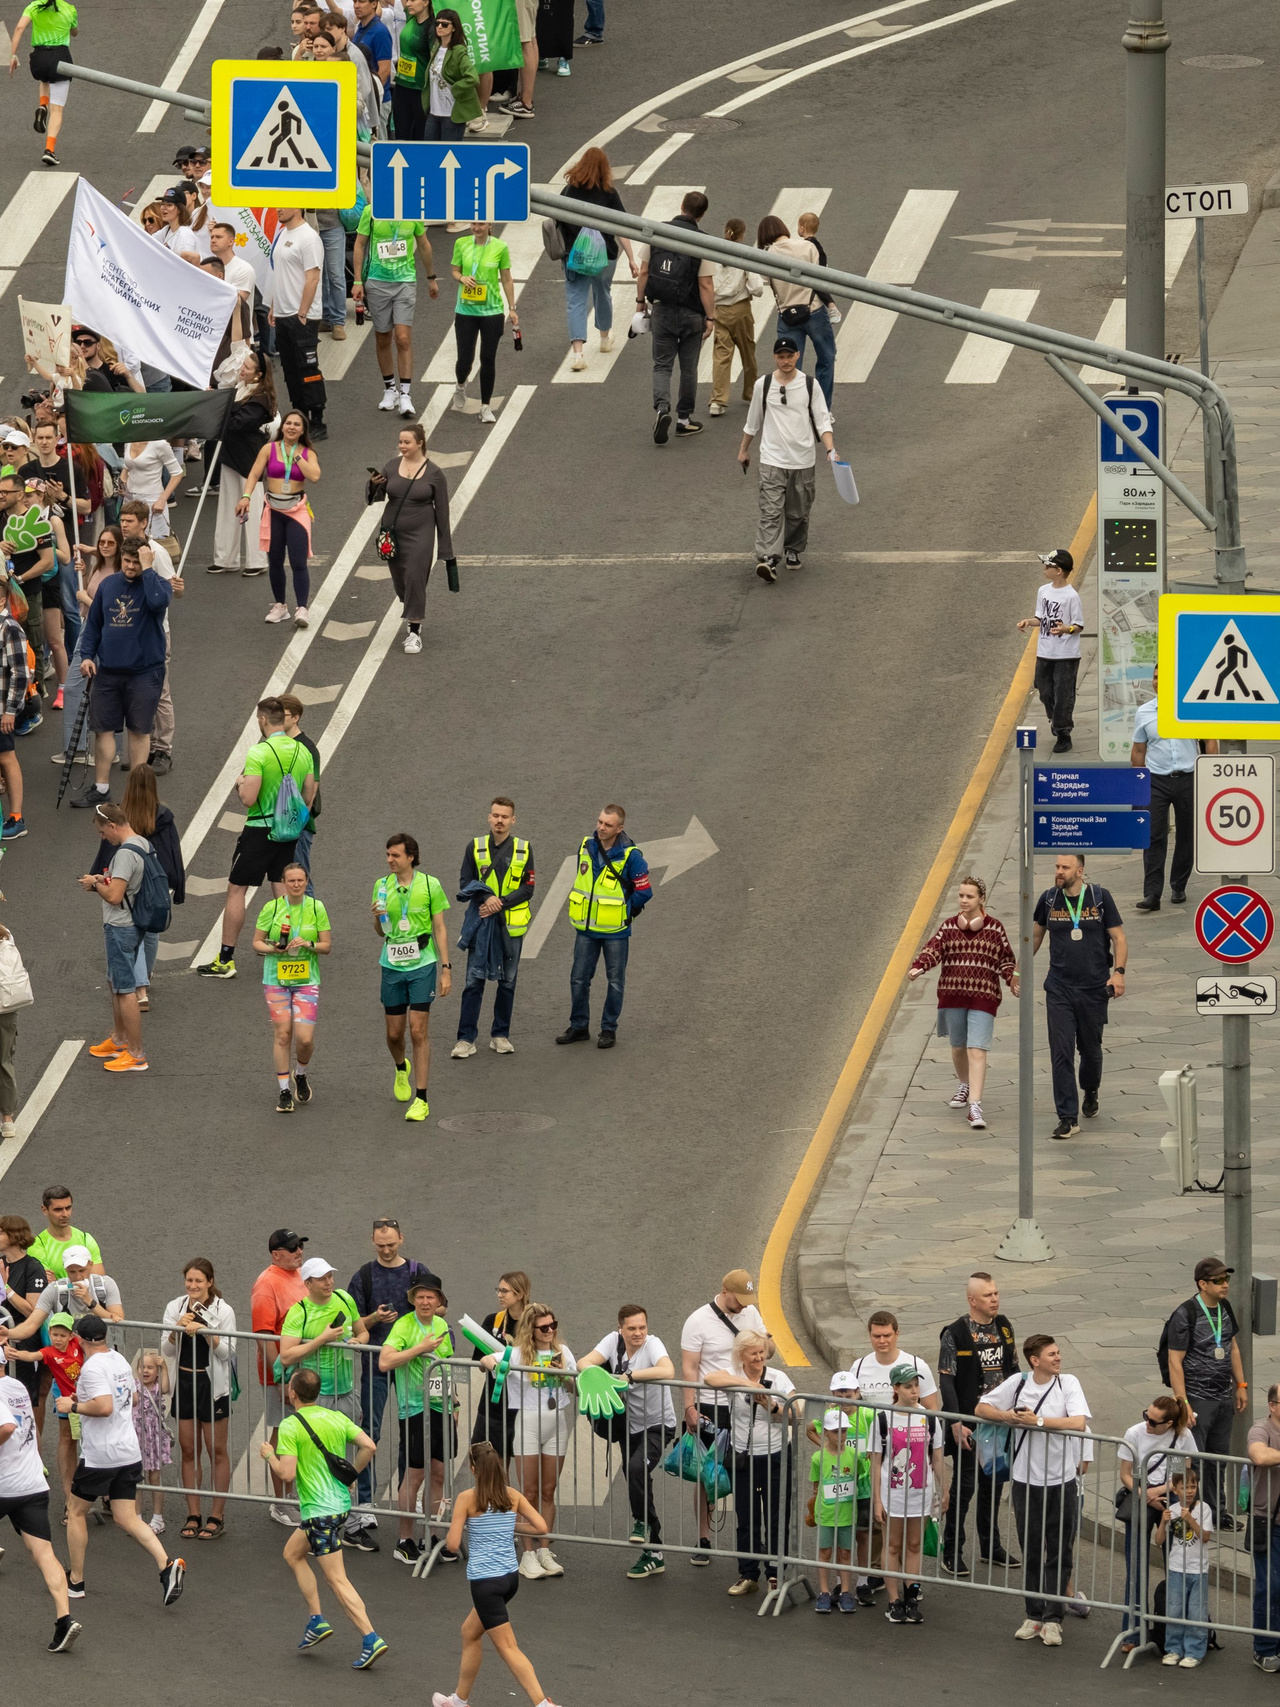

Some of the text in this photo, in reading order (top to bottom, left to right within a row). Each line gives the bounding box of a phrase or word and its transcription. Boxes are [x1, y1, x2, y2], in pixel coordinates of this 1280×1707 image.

[471, 0, 490, 62] ОМКЛИК
[1166, 189, 1232, 213] СТОП
[174, 324, 202, 341] ЛЮДИ
[177, 315, 215, 335] МЕНЯЮТ
[1116, 408, 1148, 455] P
[1213, 764, 1258, 777] ЗОНА
[1052, 782, 1089, 790] «Зарядье»
[1052, 815, 1093, 823] Концертный
[1219, 805, 1251, 828] 50
[391, 945, 415, 956] 7606
[282, 964, 305, 974] 9723
